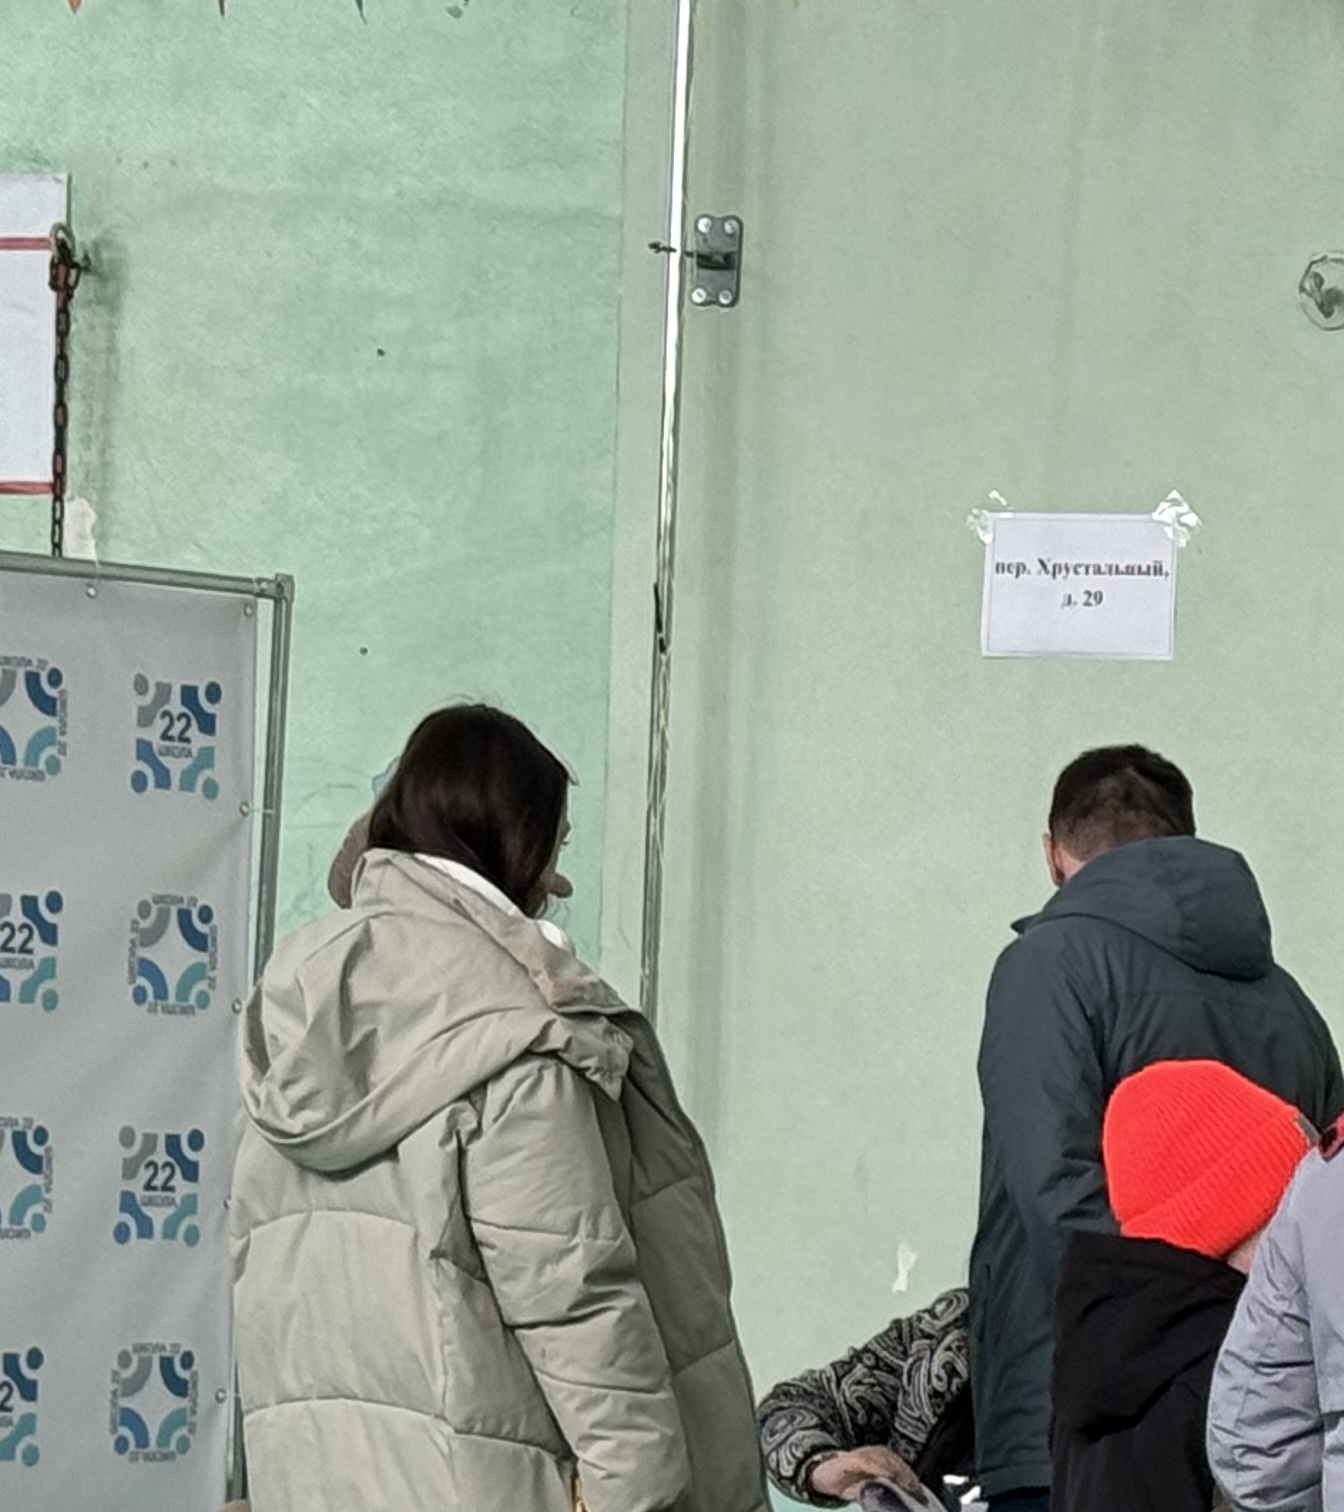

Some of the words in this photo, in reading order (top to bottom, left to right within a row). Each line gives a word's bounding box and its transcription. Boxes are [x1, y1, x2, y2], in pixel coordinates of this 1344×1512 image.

[995, 561, 1032, 579] пер.
[1037, 558, 1170, 580] Хрустальный,
[1082, 590, 1104, 607] 29
[159, 710, 193, 744] 22
[0, 923, 35, 955] 22
[142, 1161, 177, 1193] 22
